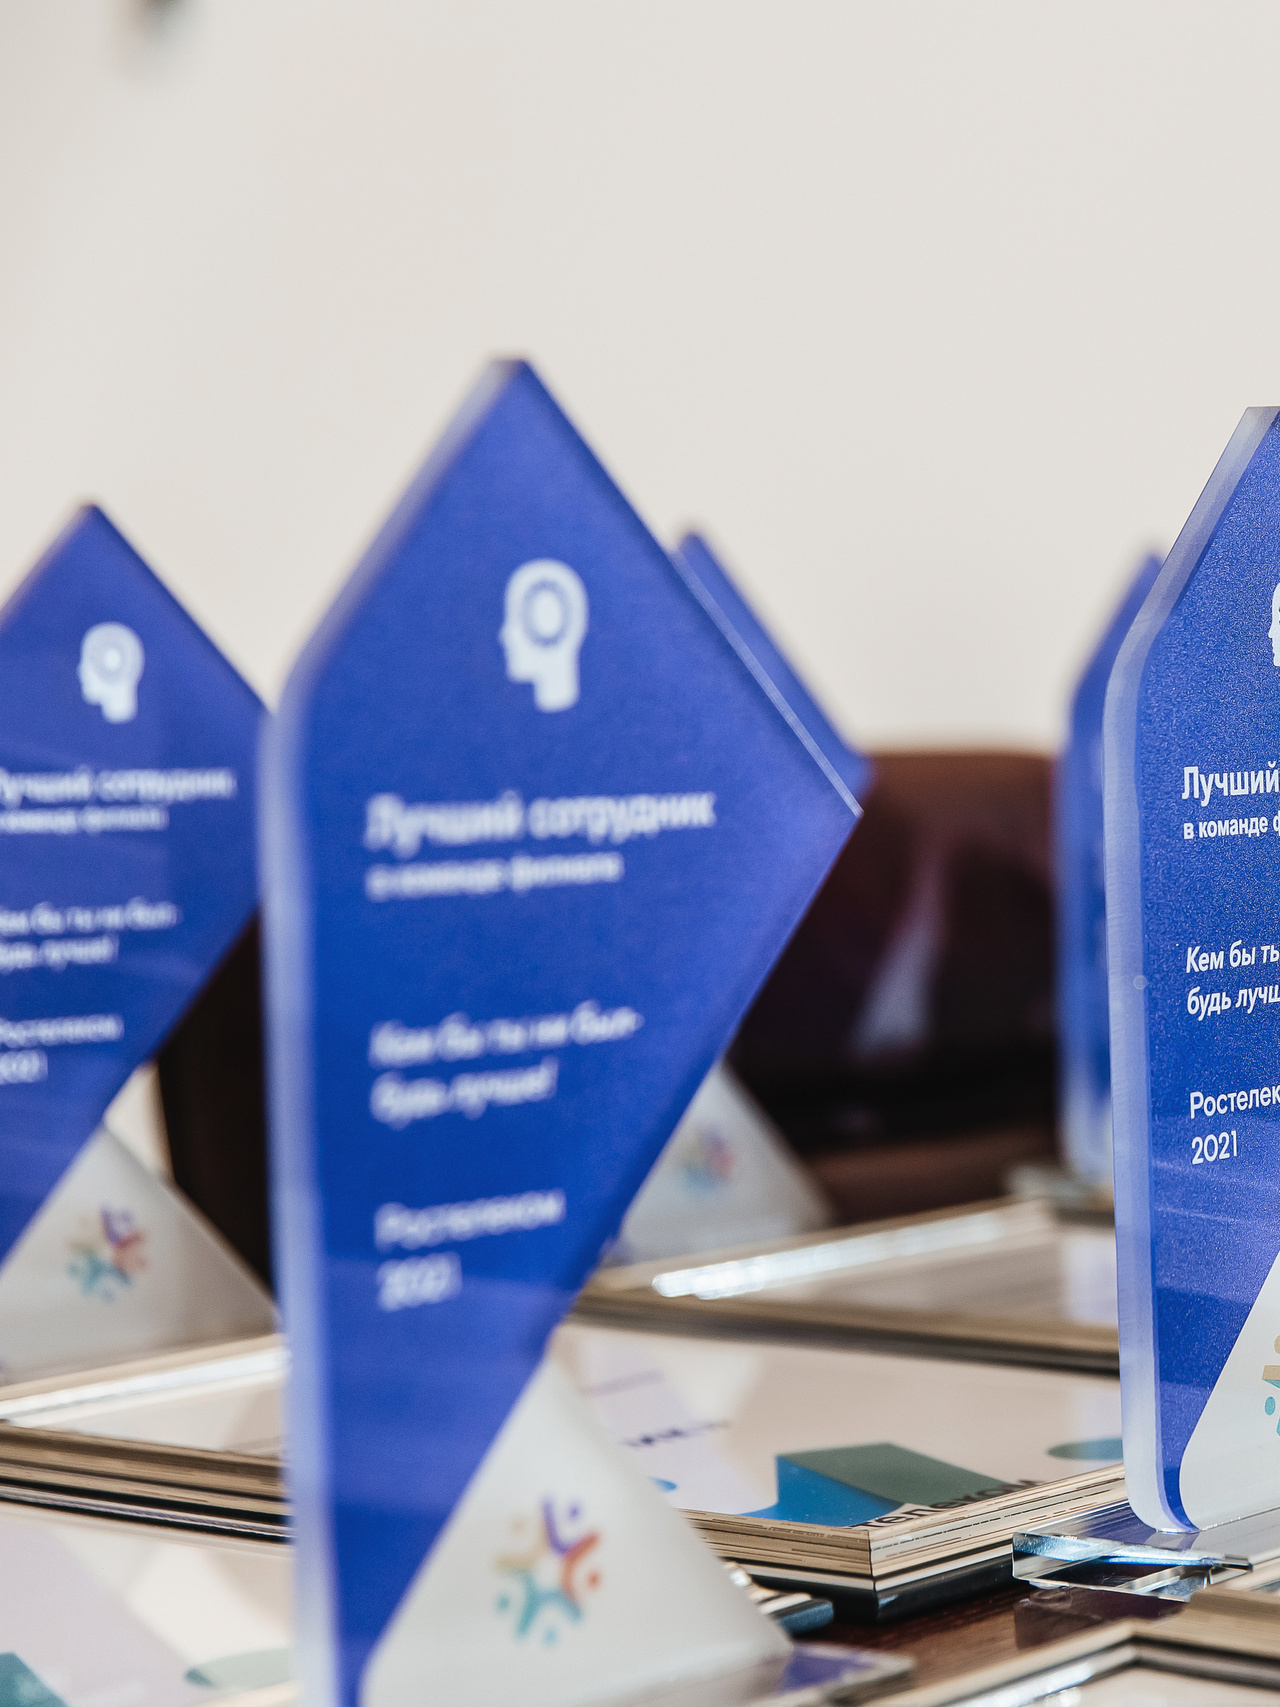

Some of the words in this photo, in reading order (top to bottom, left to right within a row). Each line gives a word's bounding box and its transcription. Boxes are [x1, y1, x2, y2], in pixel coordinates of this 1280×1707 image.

[1182, 761, 1280, 805] Лучший
[1184, 823, 1195, 839] в
[1198, 813, 1269, 838] команде
[1186, 944, 1224, 973] Кем
[1229, 938, 1256, 966] бы
[1187, 987, 1232, 1021] будь
[1191, 1131, 1238, 1165] 2021
